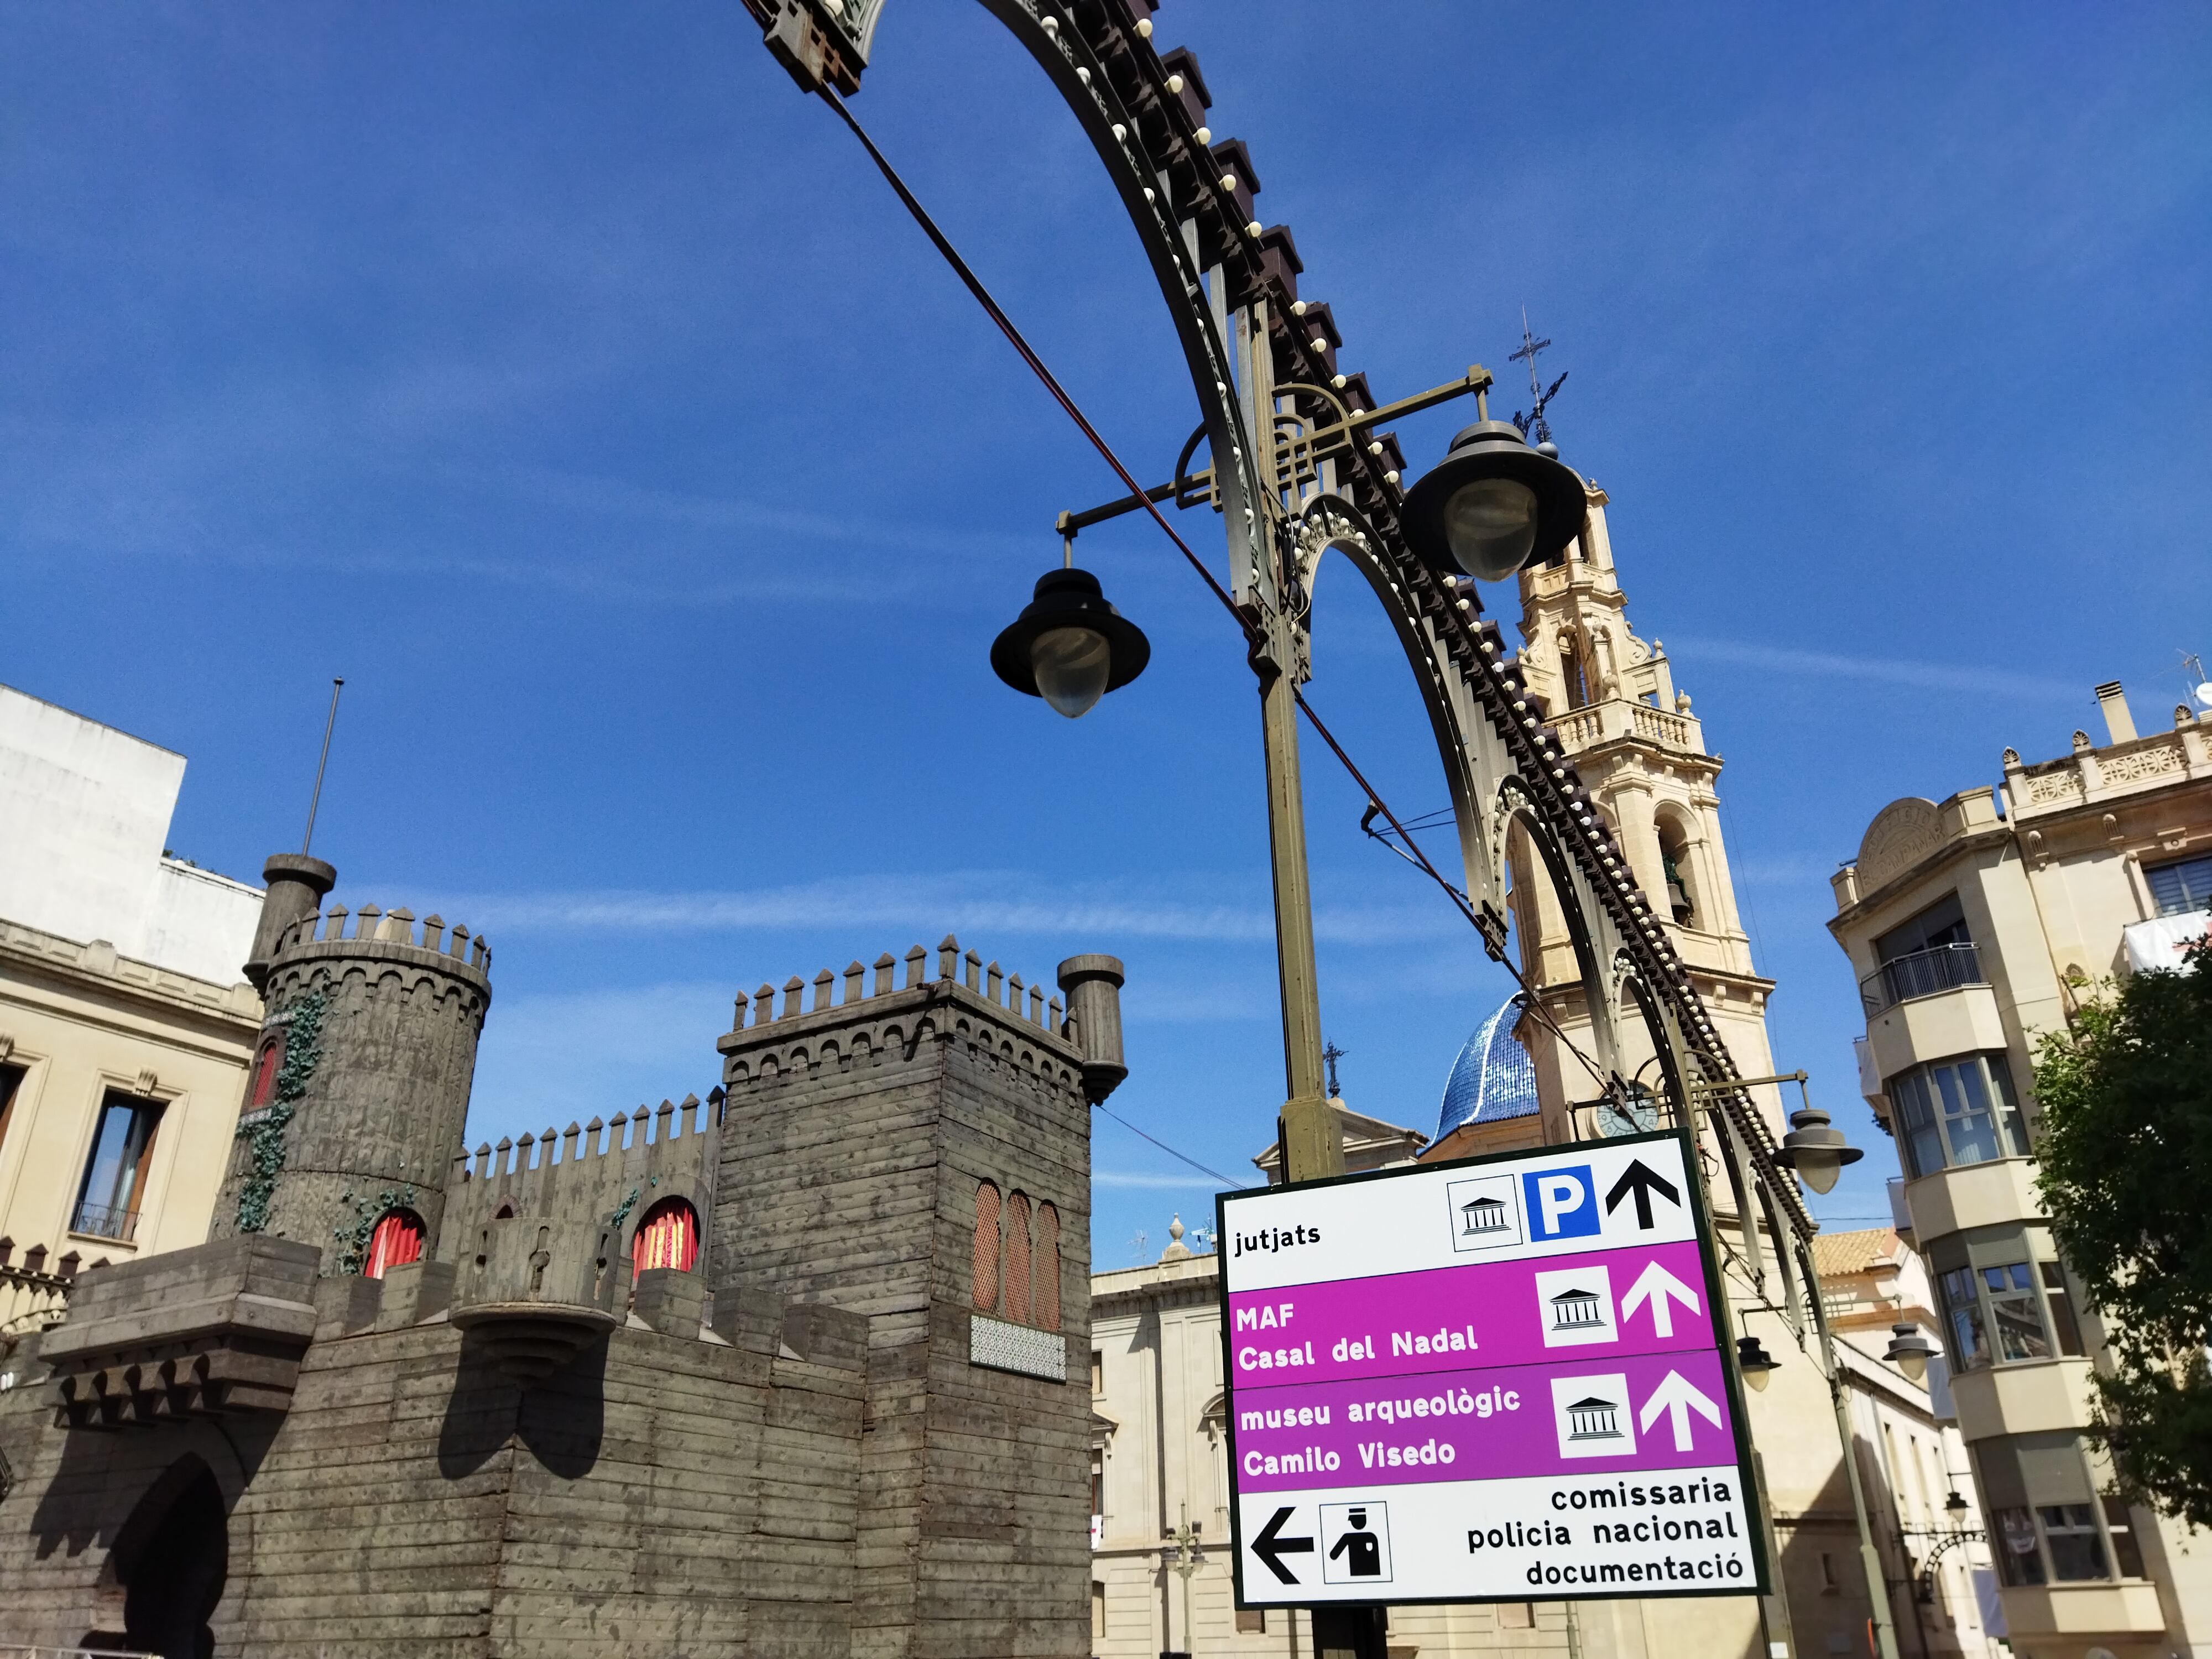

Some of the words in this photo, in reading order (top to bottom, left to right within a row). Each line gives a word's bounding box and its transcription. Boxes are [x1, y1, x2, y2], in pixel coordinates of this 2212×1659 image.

[1538, 1175, 1584, 1234] P
[1235, 1225, 1320, 1257] jutjats
[1237, 1303, 1293, 1331] MAF
[1239, 1342, 1314, 1370] Casal
[1332, 1335, 1375, 1362] del
[1392, 1326, 1478, 1356] Nadal
[1241, 1406, 1330, 1431] museu
[1348, 1386, 1520, 1424] arqueològic
[1244, 1447, 1340, 1476] Camilo
[1358, 1439, 1455, 1468] Visedo
[1552, 1477, 1731, 1510] comissaria
[1468, 1520, 1571, 1553] policia
[1594, 1512, 1738, 1543] nacional
[1527, 1553, 1743, 1584] documentació
